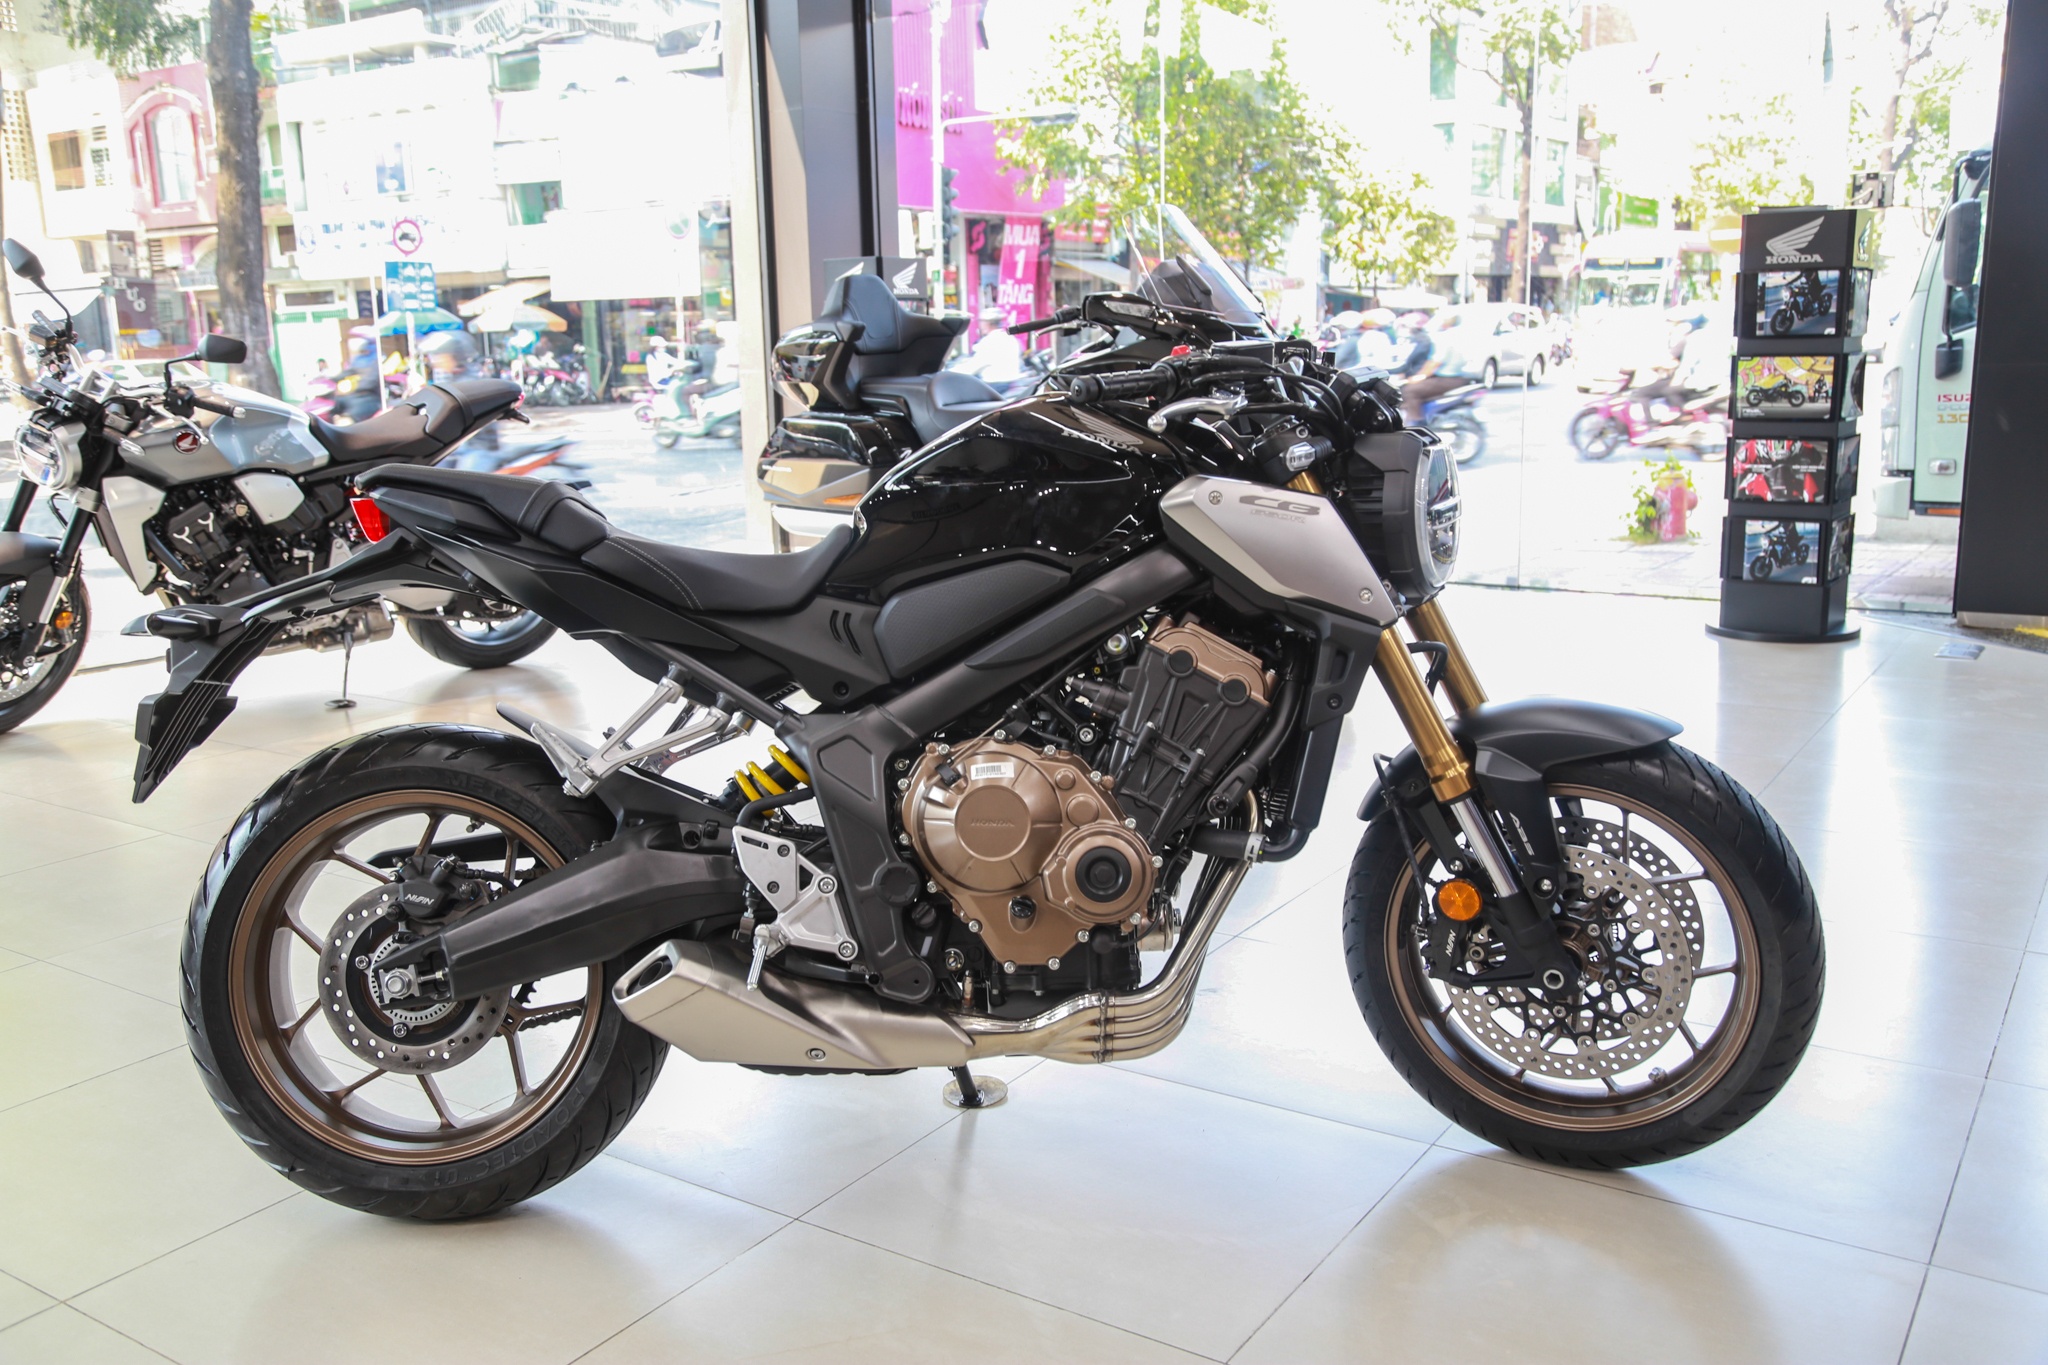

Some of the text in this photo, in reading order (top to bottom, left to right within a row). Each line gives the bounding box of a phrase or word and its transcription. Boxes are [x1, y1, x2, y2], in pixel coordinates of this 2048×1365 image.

[1003, 224, 1040, 246] MUA
[1015, 248, 1026, 279] 1
[1765, 254, 1824, 264] HONDA
[997, 279, 1034, 310] TẶNG
[1061, 429, 1143, 456] HONDA
[1239, 495, 1320, 516] CB
[970, 818, 1015, 828] HONDA
